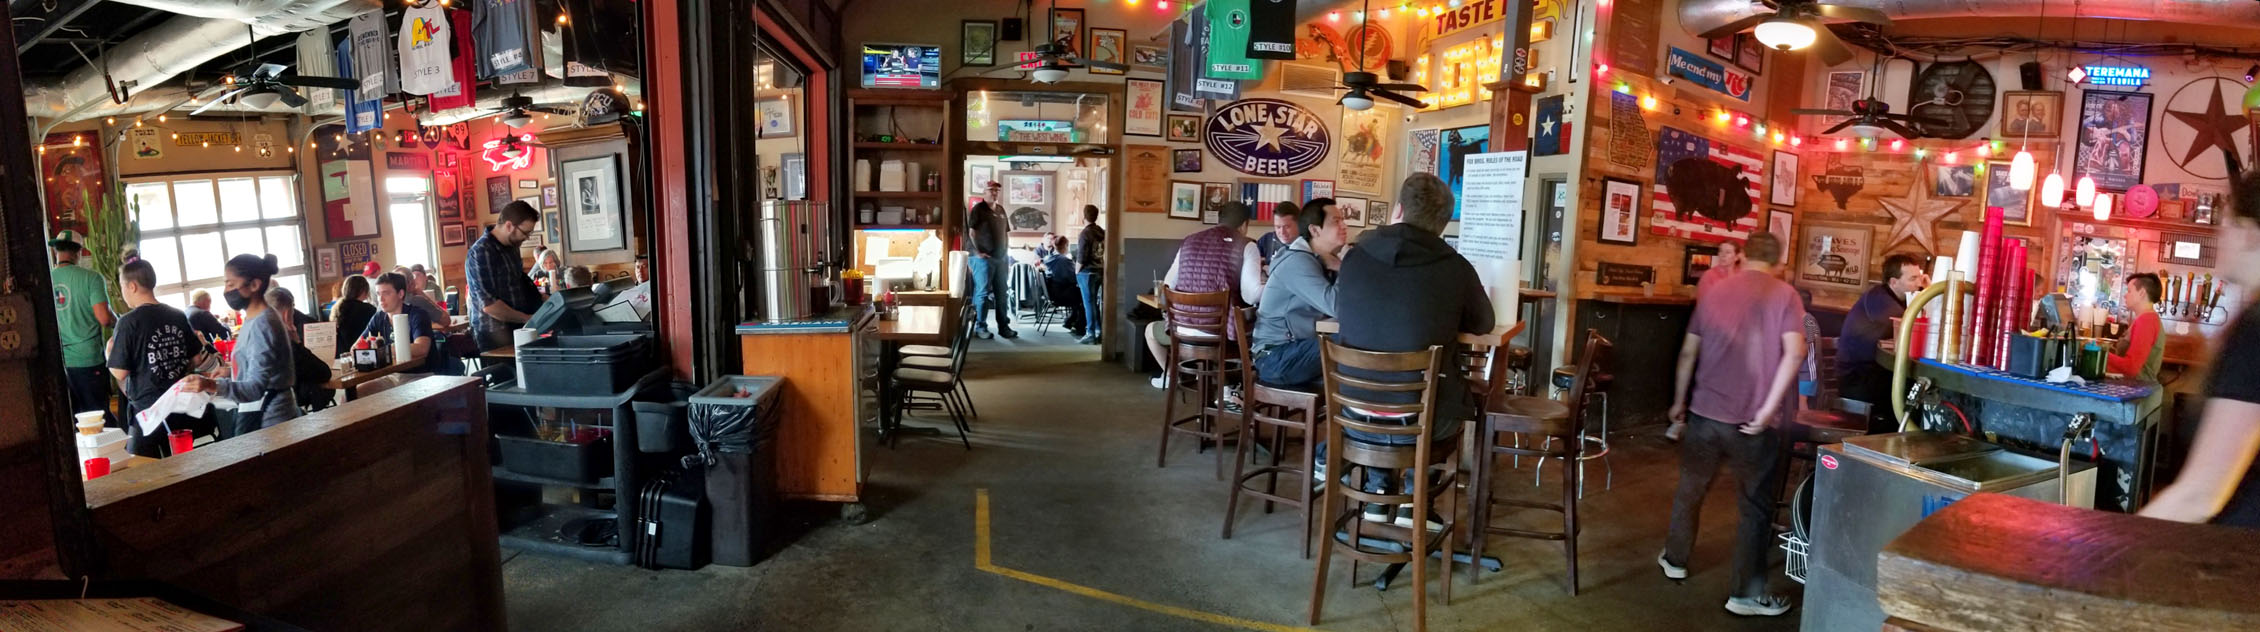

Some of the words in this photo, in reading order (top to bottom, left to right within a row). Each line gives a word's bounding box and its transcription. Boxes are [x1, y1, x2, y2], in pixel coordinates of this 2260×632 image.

[1435, 0, 1494, 35] TASTE
[1253, 42, 1276, 50] STYLE
[1277, 44, 1291, 52] #10
[493, 56, 511, 67] STYLE
[414, 67, 432, 79] STYLE
[435, 66, 440, 74] 3
[1212, 64, 1233, 72] STYLE
[1671, 54, 1686, 69] Me
[1706, 70, 1722, 84] my
[2085, 66, 2149, 78] TEREMANA
[501, 72, 527, 82] STYLE
[2107, 77, 2141, 86] TEQUILA
[1197, 80, 1218, 89] STYLE
[1220, 82, 1233, 90] #12
[1217, 104, 1267, 132] LONE
[1275, 106, 1319, 140] STAR
[423, 125, 440, 142] 20
[454, 124, 465, 135] 89
[1033, 132, 1049, 141] WEST
[1245, 155, 1289, 175] BEER
[343, 242, 367, 257] CLOSED
[148, 328, 162, 350] FOX
